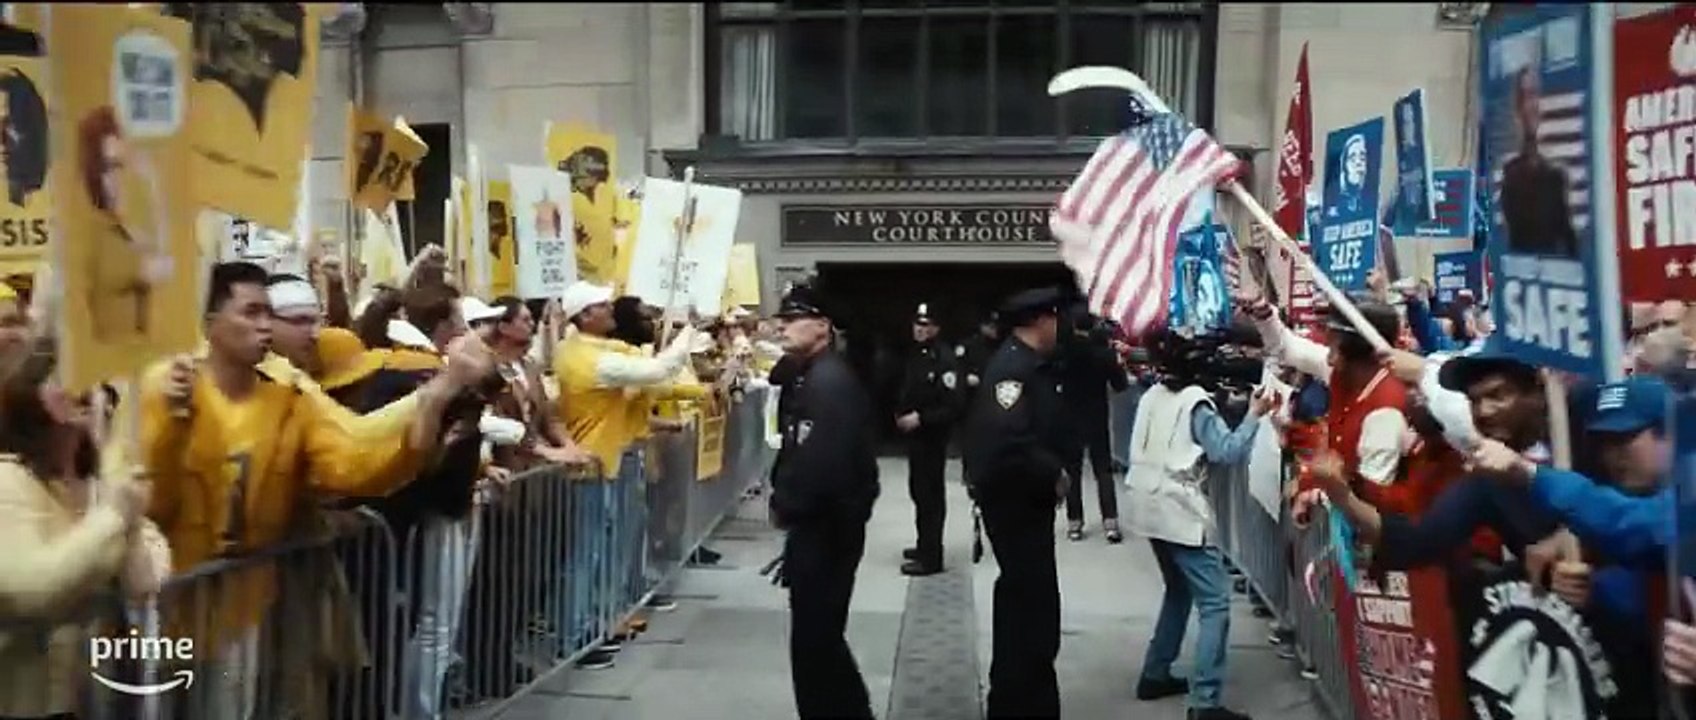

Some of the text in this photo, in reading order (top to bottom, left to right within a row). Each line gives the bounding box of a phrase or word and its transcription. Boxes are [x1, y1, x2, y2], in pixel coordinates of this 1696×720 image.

[1626, 129, 1696, 185] SAF
[834, 210, 1052, 226] NEW YORK COUN
[872, 226, 1037, 242] COURTHOUSE
[1330, 240, 1362, 271] SAFE
[1503, 279, 1592, 358] SAFE
